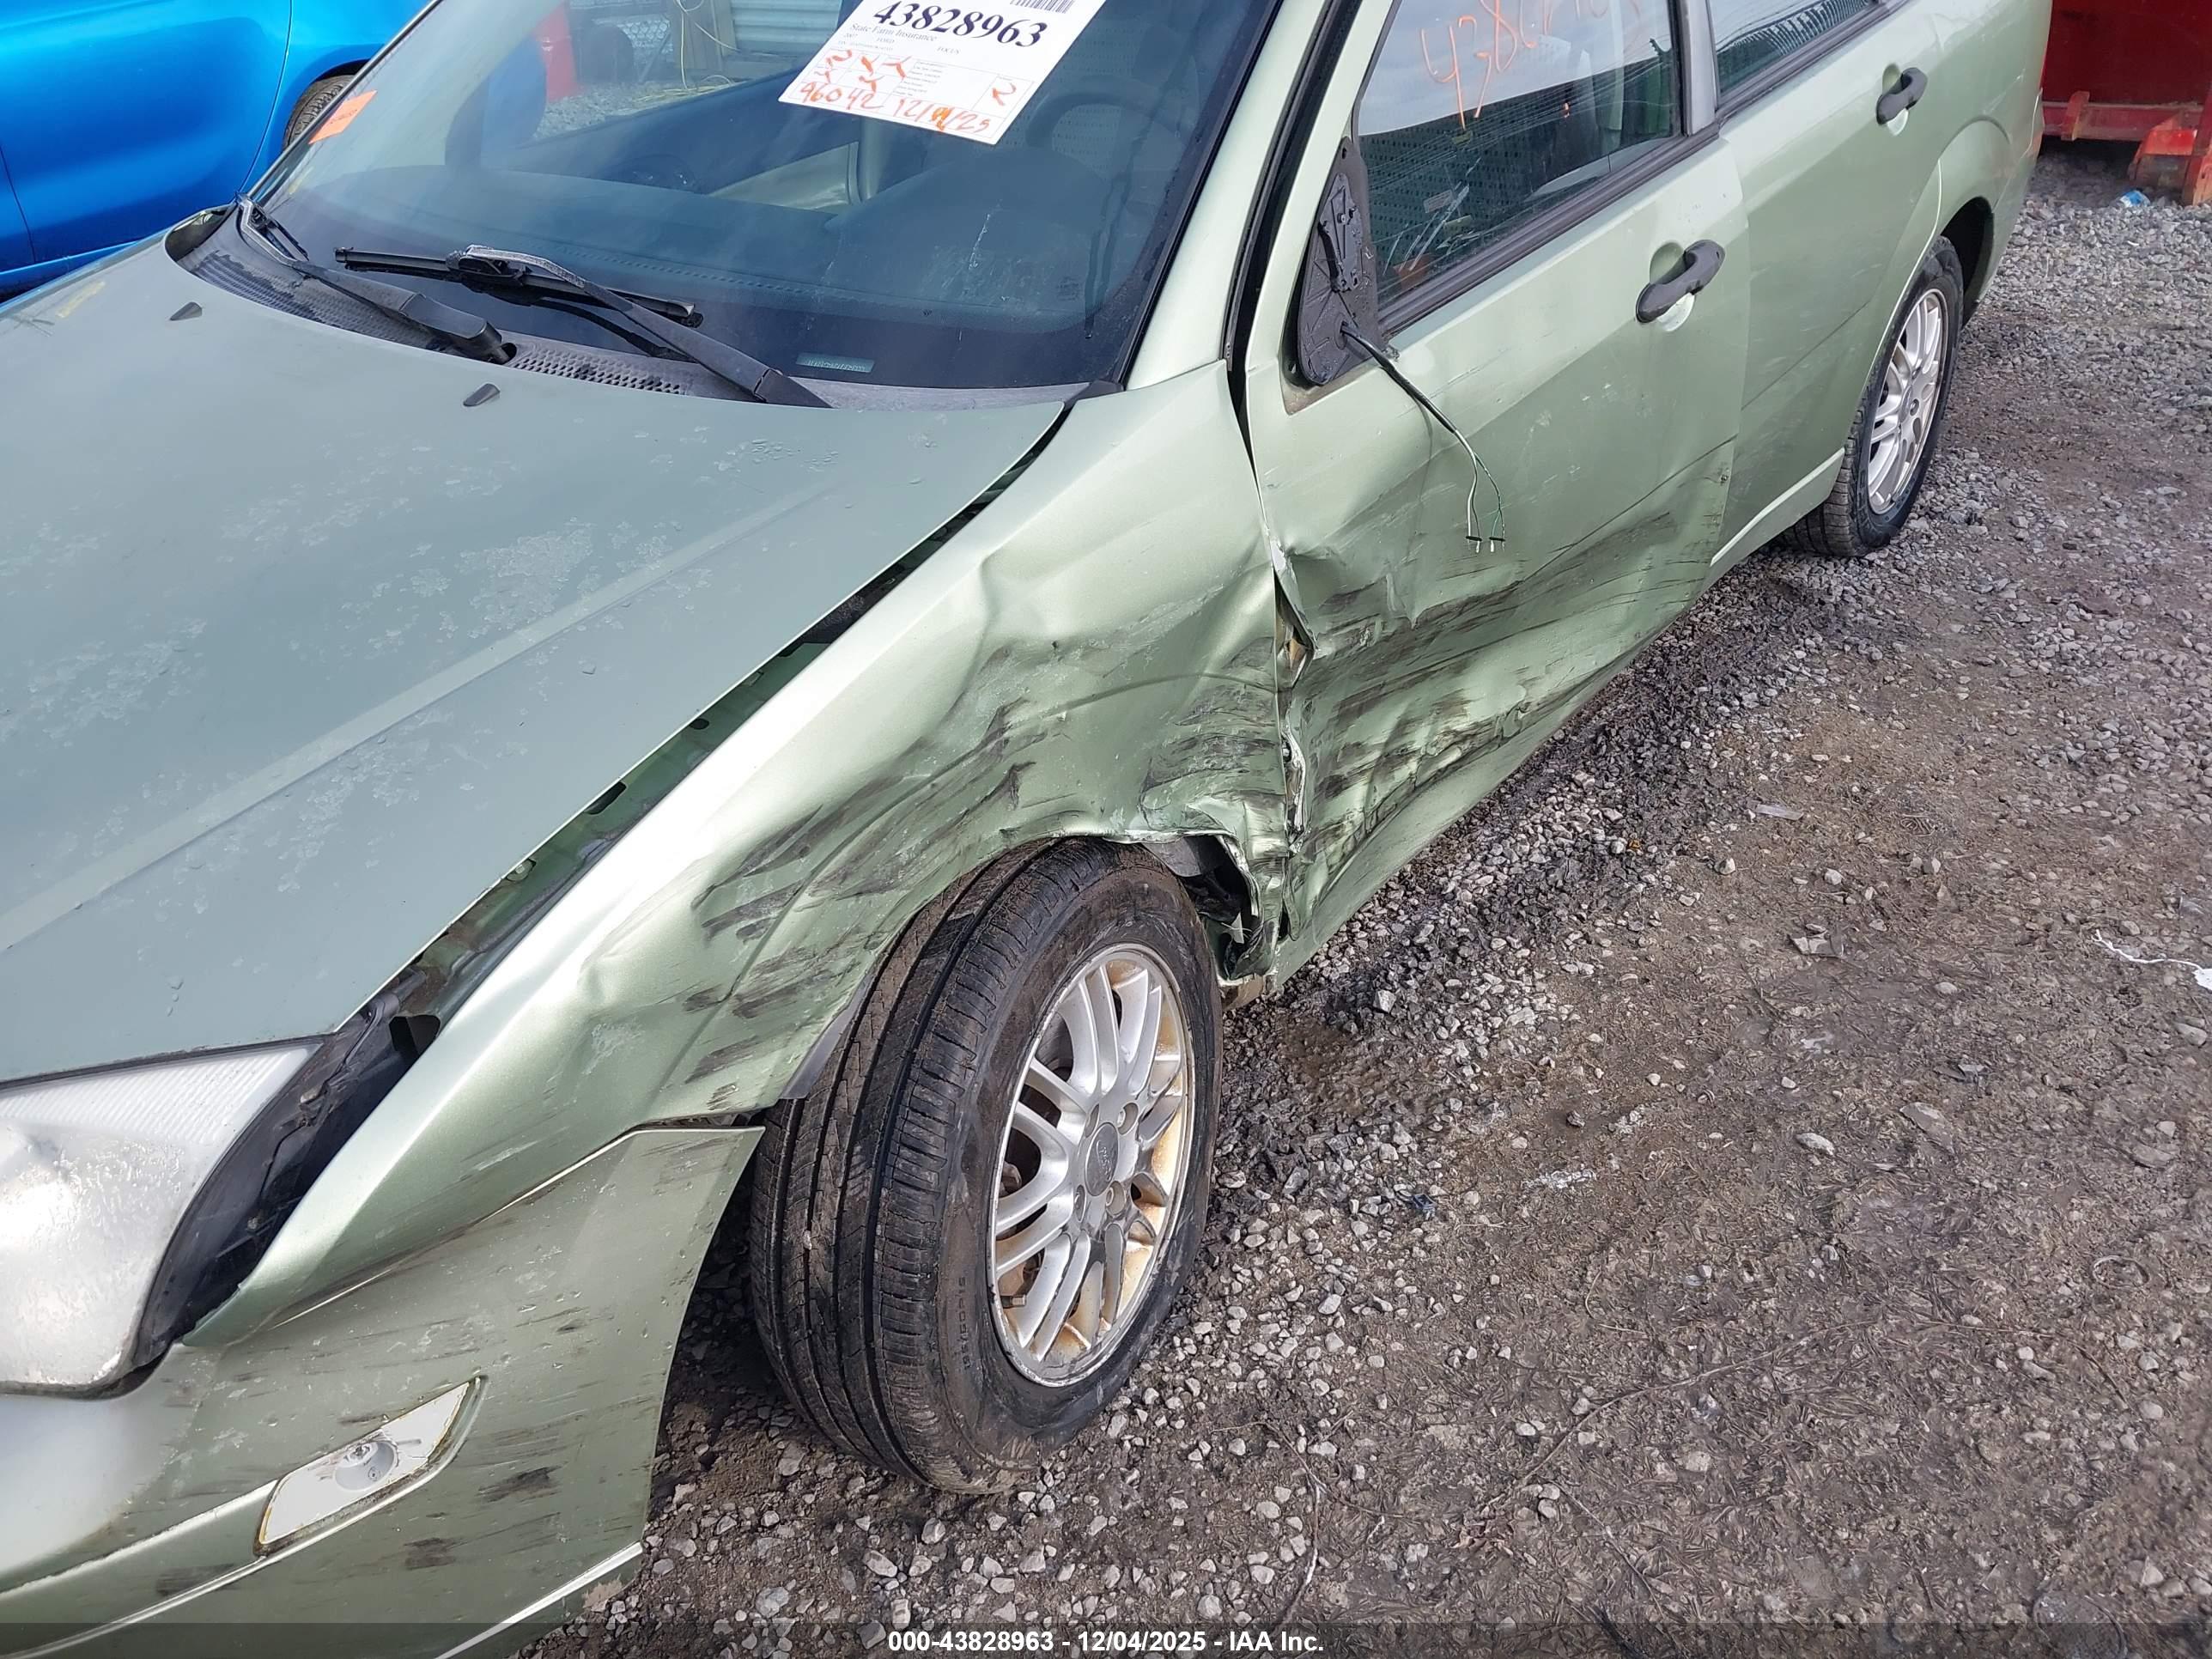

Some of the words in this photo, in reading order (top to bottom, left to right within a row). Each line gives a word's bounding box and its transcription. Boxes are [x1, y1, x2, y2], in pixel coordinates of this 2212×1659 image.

[851, 23, 872, 33] State
[896, 29, 938, 41] Insurance
[874, 1, 1048, 47] 43828963
